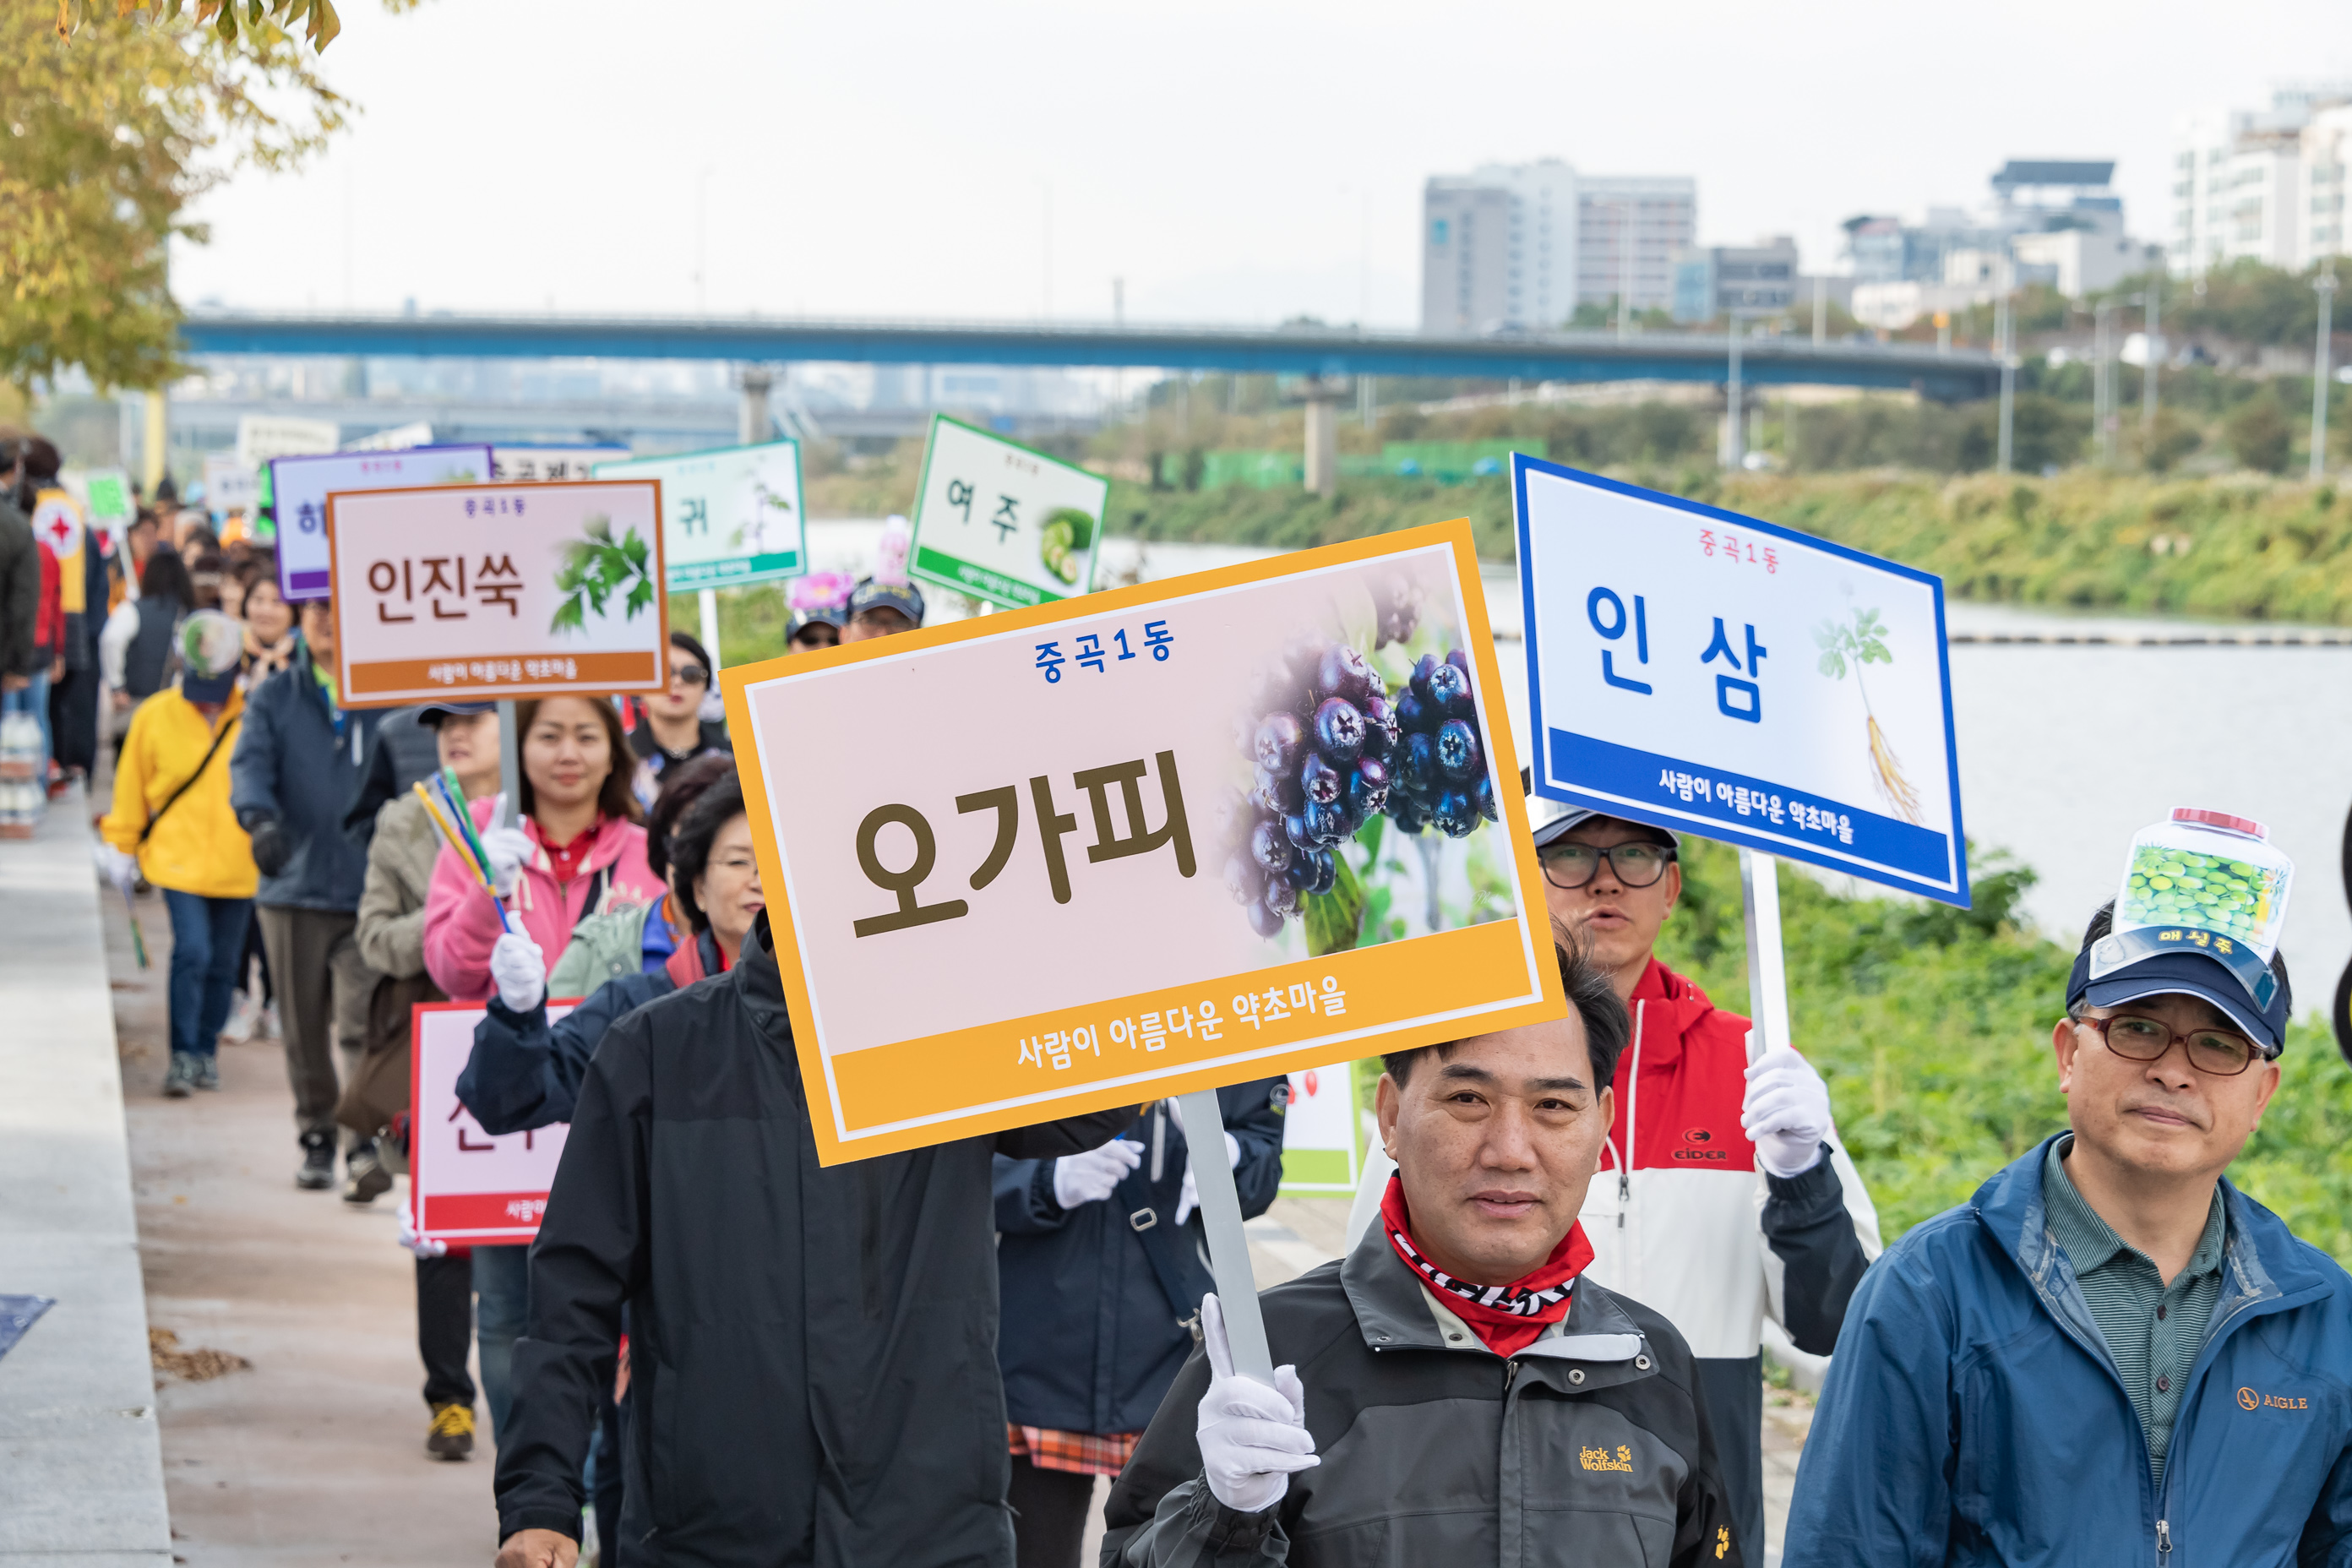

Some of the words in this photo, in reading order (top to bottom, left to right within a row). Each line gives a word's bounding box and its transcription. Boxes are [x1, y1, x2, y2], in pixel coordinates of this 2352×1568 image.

[1699, 529, 1778, 574] 중곡1동
[368, 555, 524, 624] 인진쑥
[1035, 620, 1173, 683] 중곡1동
[1658, 769, 1711, 803] 사람이
[1716, 782, 1785, 825] 아름다운
[1788, 801, 1854, 845] 약초마을
[853, 749, 1196, 938] 오가피
[2159, 930, 2233, 954] 매실주
[1017, 1024, 1100, 1070] 사람이
[1109, 1000, 1223, 1053] 아름다운
[1232, 975, 1347, 1031] 약초마을
[2263, 1394, 2308, 1409] AIGLE
[1579, 1446, 1609, 1460] Jack
[1579, 1459, 1633, 1473] Wolfskin
